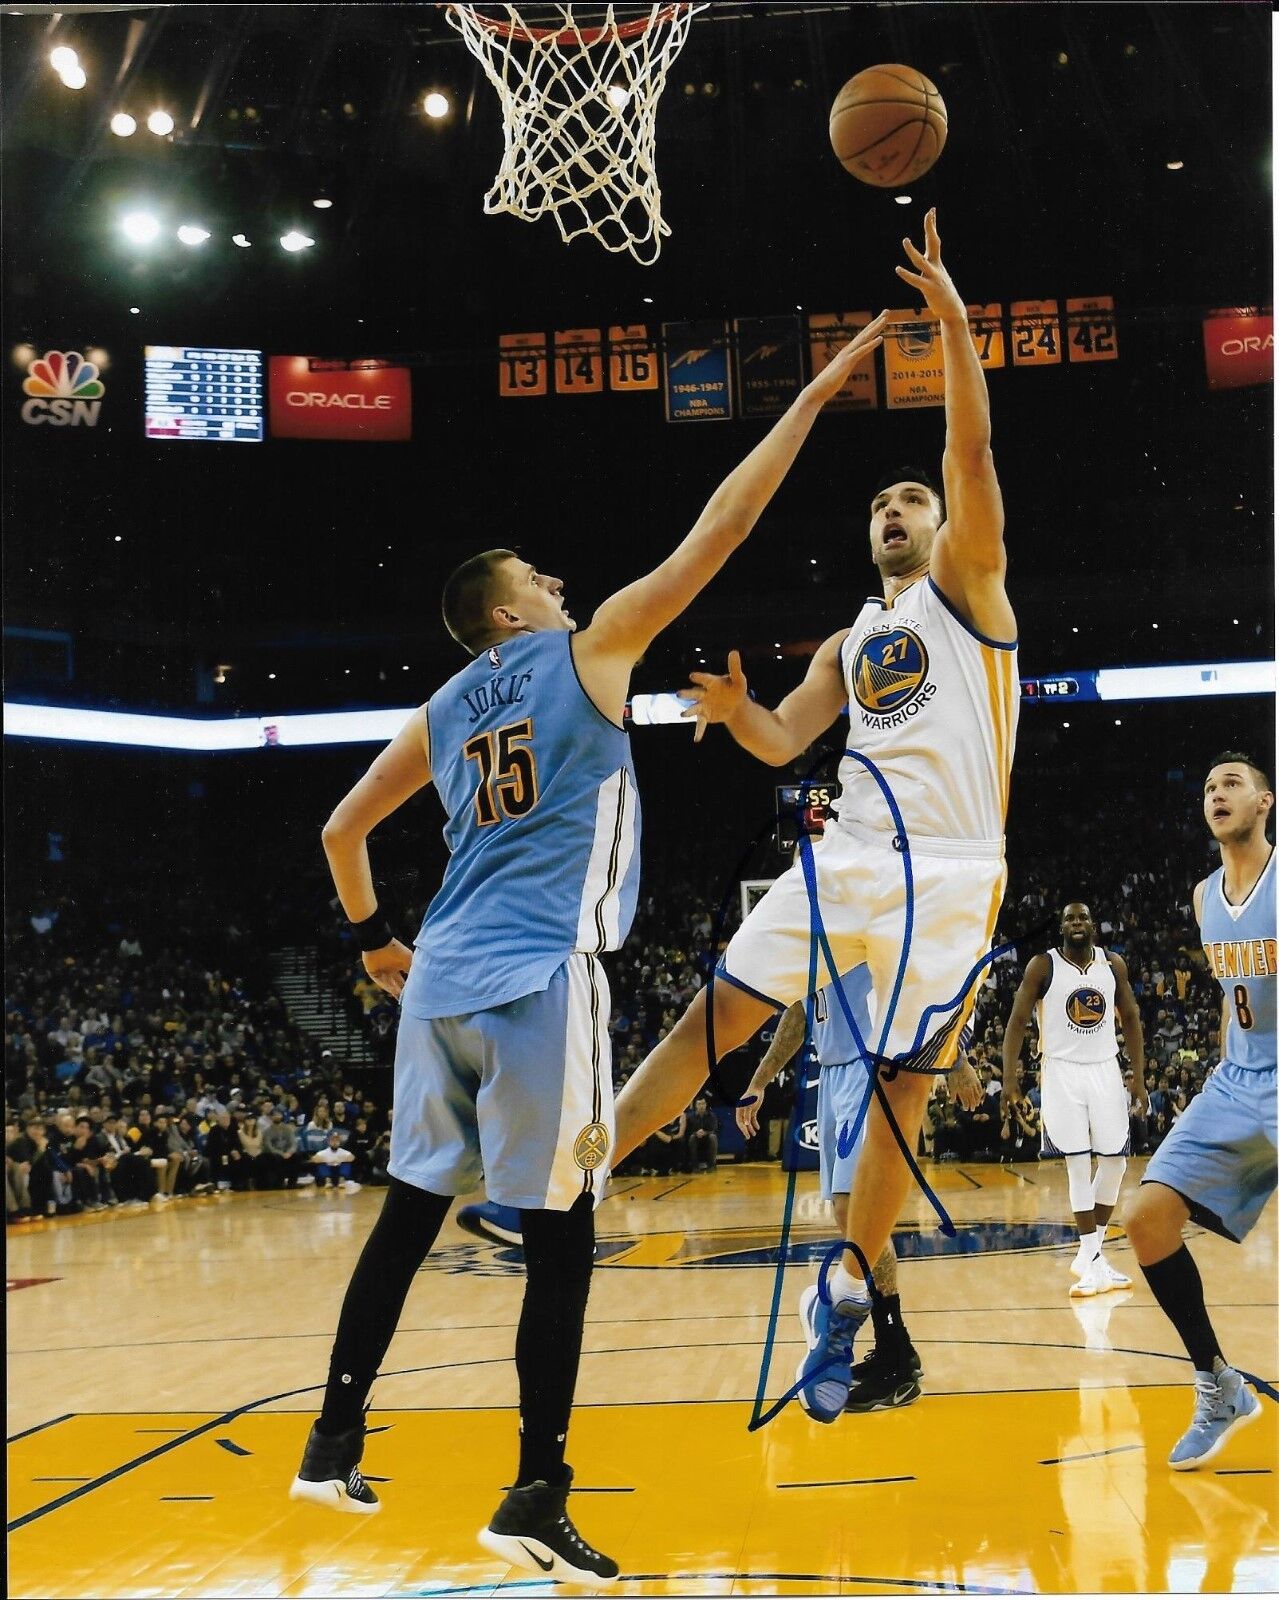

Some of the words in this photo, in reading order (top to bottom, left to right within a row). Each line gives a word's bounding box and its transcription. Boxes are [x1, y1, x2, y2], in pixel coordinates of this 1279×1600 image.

[975, 326, 993, 360] 7
[1015, 325, 1057, 357] 24
[1074, 321, 1113, 353] 42
[508, 355, 538, 388] 13
[564, 352, 594, 385] 14
[617, 351, 650, 382] 16
[893, 369, 944, 380] 2014-2015
[286, 391, 393, 409] ORACLE
[673, 382, 724, 393] 1946-1947
[894, 394, 945, 404] CHAMPIONS
[909, 386, 928, 394] NBA
[22, 398, 102, 427] CSN
[674, 407, 725, 418] CHAMPIONS
[688, 399, 708, 408] NBA
[881, 635, 909, 667] 27
[463, 668, 533, 723] JOKIĆ
[860, 682, 938, 730] WARRIORS
[462, 717, 539, 826] 15
[1086, 995, 1101, 1007] 23
[1234, 984, 1255, 1030] 8
[1067, 1020, 1107, 1035] WARRIORS
